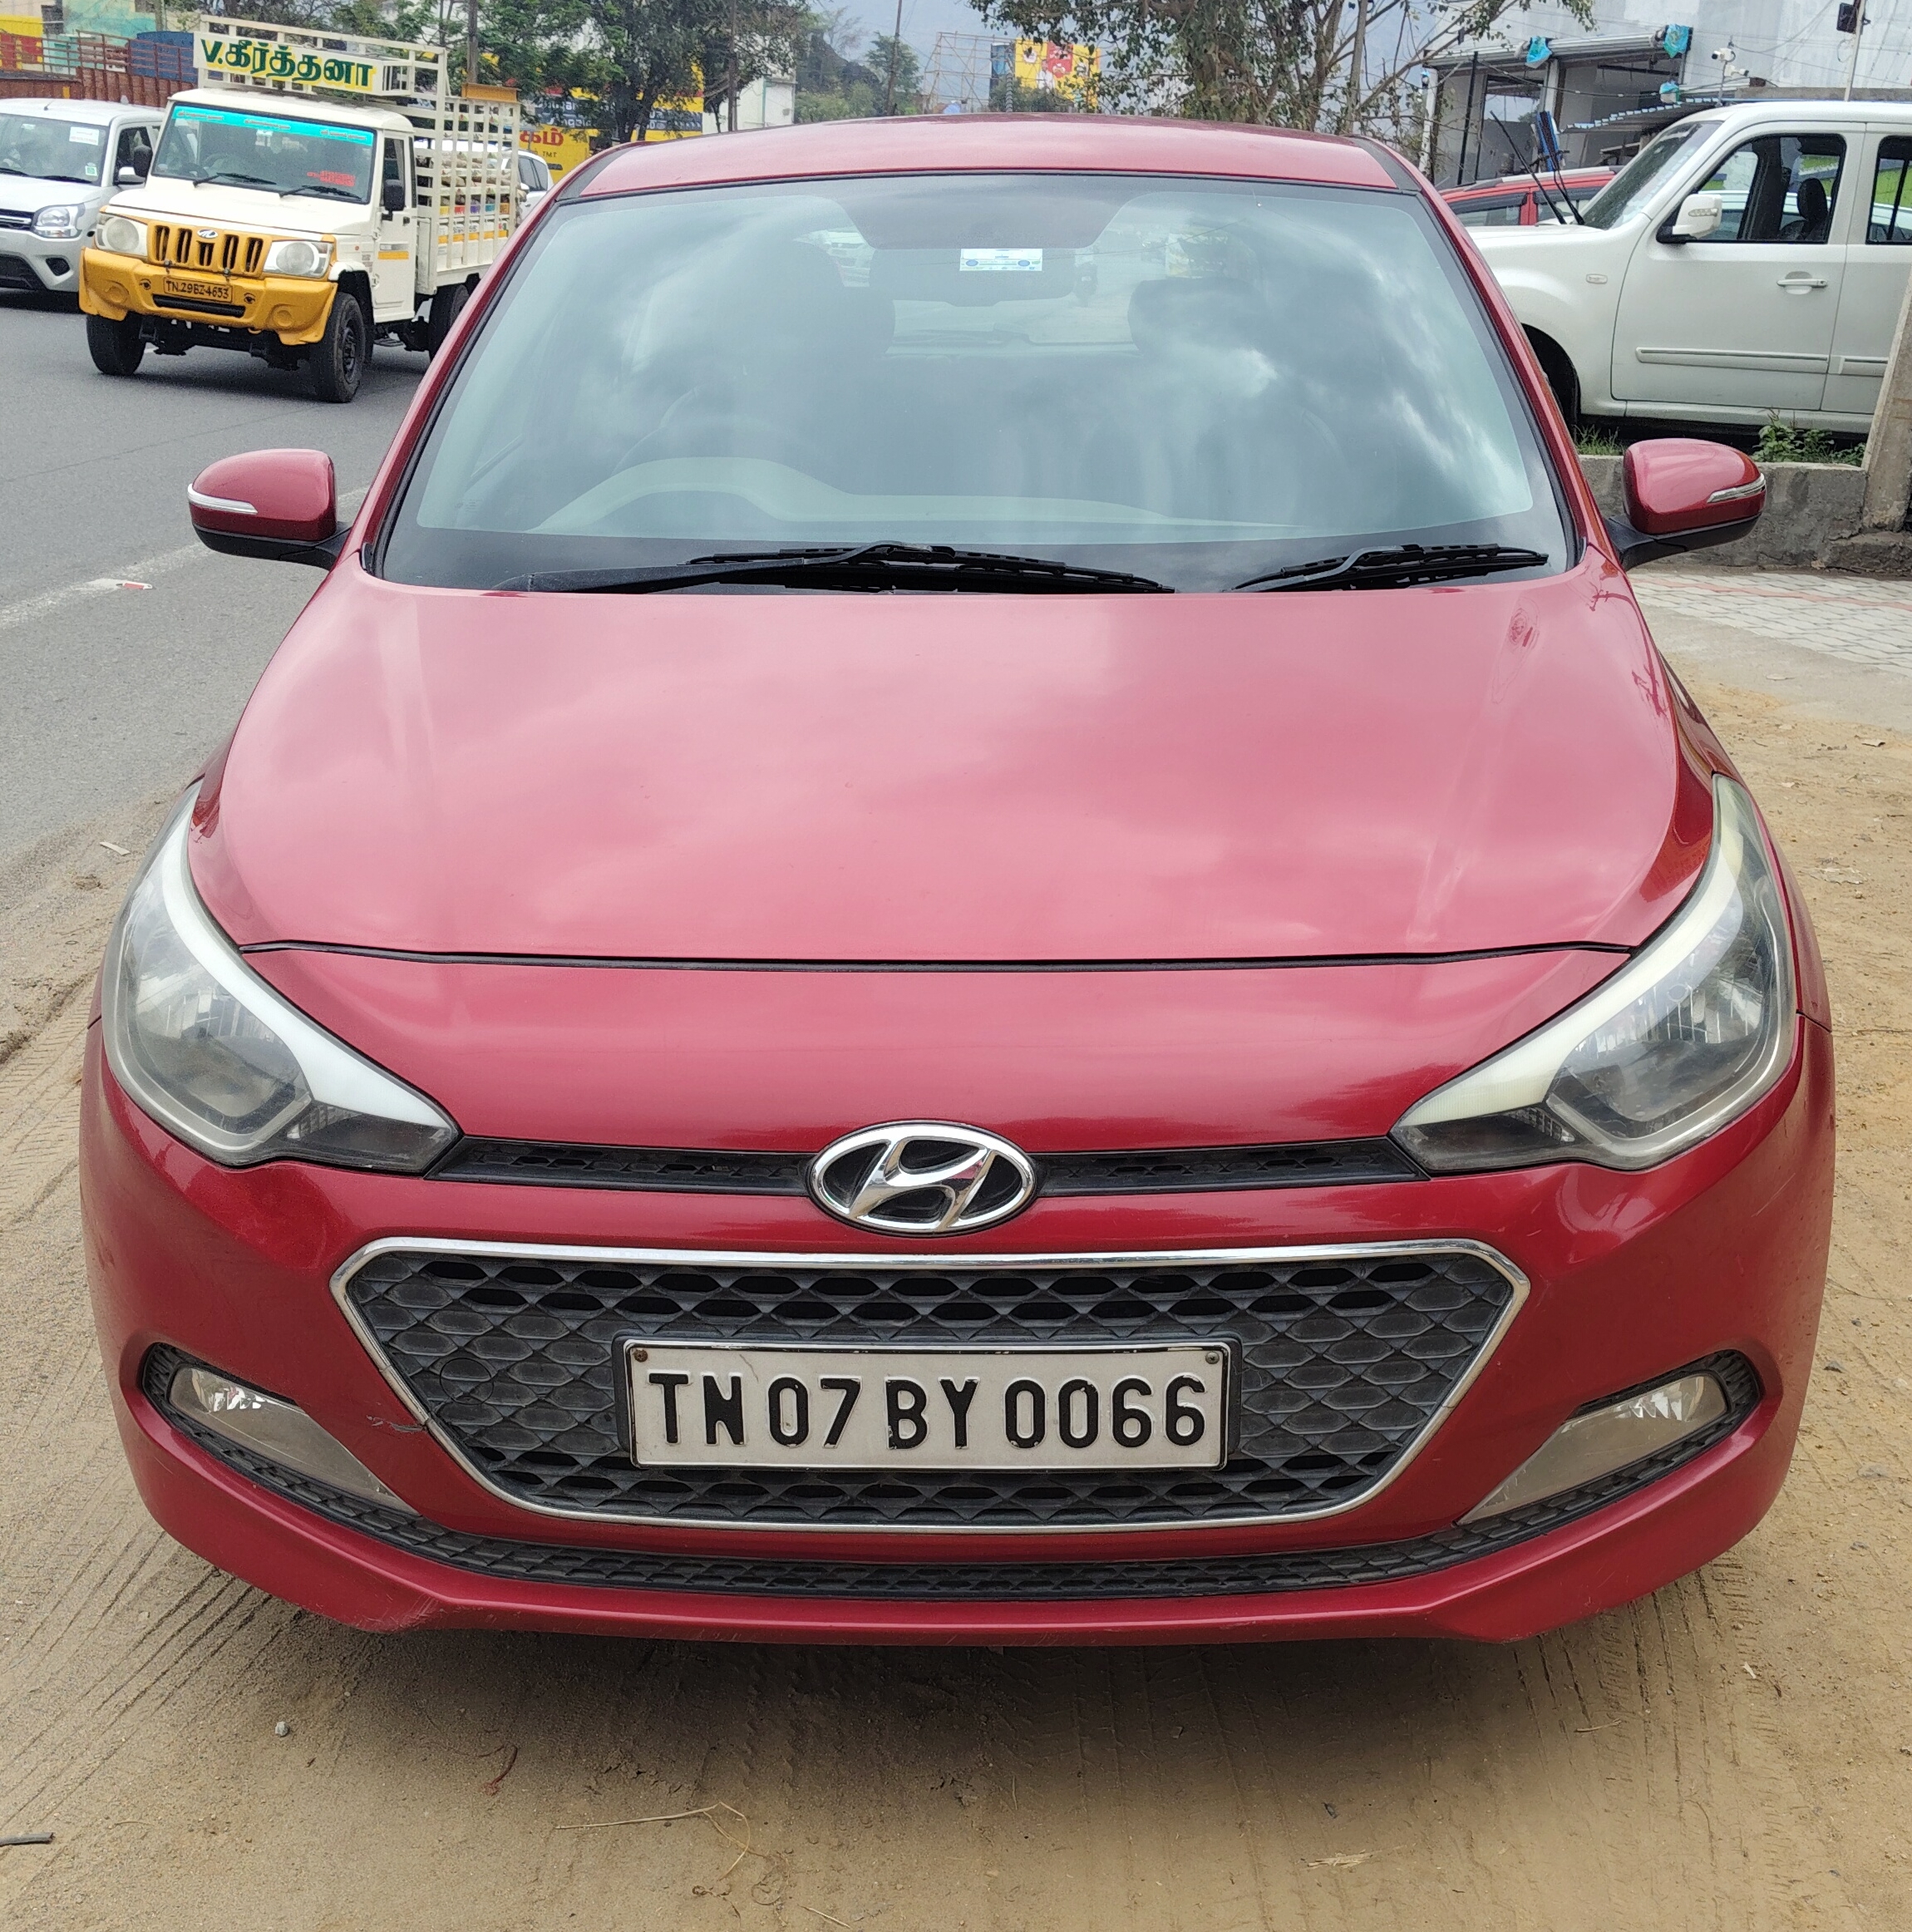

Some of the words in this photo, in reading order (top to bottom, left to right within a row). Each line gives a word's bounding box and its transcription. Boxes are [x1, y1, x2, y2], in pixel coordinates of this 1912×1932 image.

[648, 1372, 744, 1446] TN
[767, 1376, 861, 1448] 07
[886, 1377, 979, 1450] BY
[1003, 1374, 1207, 1450] 0066
